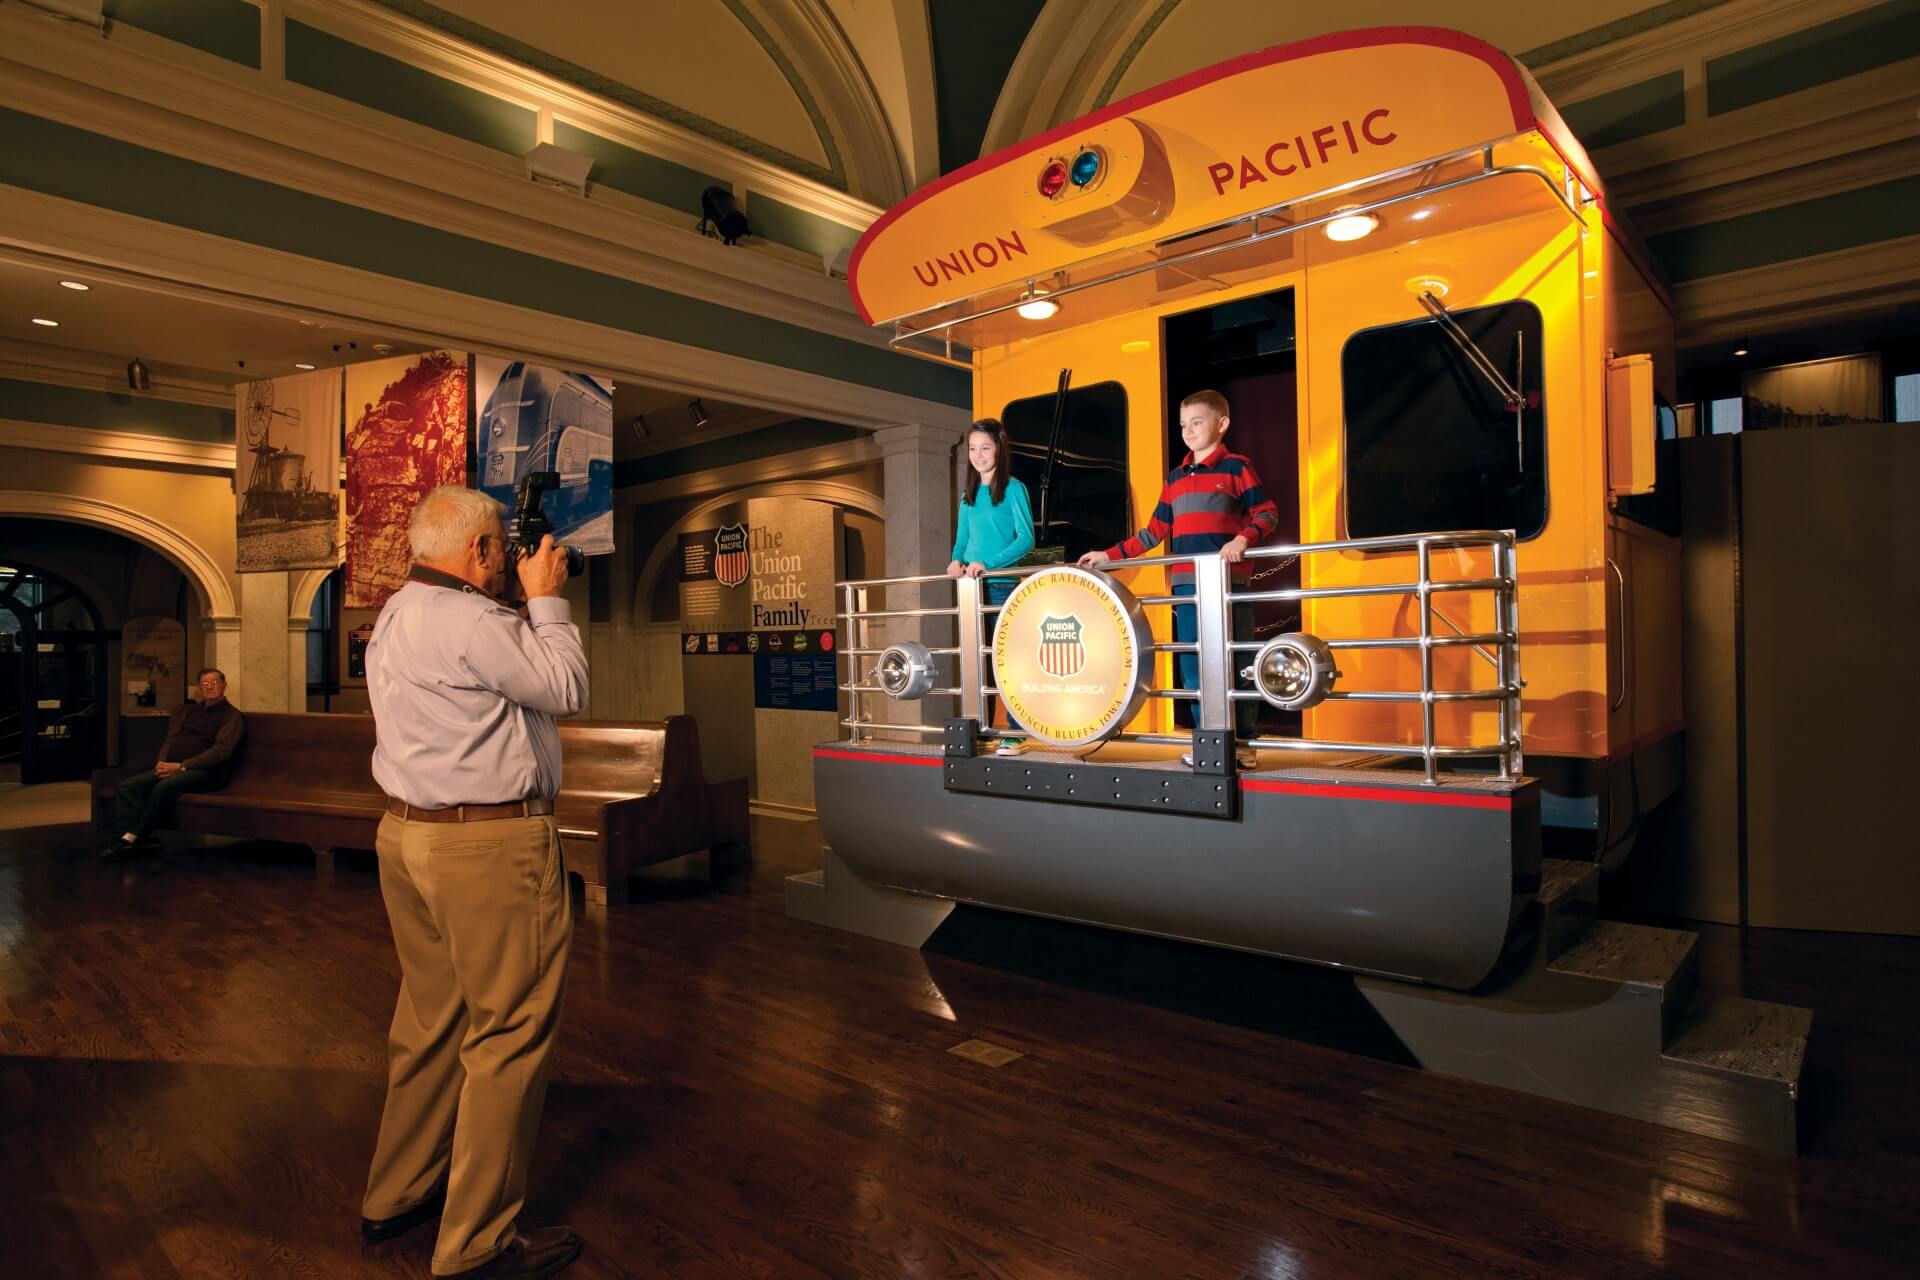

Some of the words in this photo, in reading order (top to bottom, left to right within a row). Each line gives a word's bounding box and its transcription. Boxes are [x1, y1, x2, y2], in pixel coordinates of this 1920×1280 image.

[913, 230, 1028, 287] UNION
[1207, 109, 1398, 196] PACIFIC
[720, 541, 742, 551] PACIFIC
[721, 533, 741, 543] UNION
[751, 526, 783, 551] The
[752, 550, 802, 575] Union
[752, 574, 807, 602] Pacific
[753, 601, 810, 633] Family
[997, 619, 1009, 667] UNION
[1006, 576, 1047, 616] PACIFIC
[1050, 573, 1110, 602] RAILROAD
[1109, 603, 1132, 669] MUSEUM
[1046, 622, 1075, 631] UNION
[1045, 631, 1077, 640] PACIFIC
[1022, 683, 1060, 694] BUILDING
[1062, 684, 1105, 695] AMERICA
[1009, 695, 1050, 736] COUNCIL
[1099, 699, 1123, 727] IOWA
